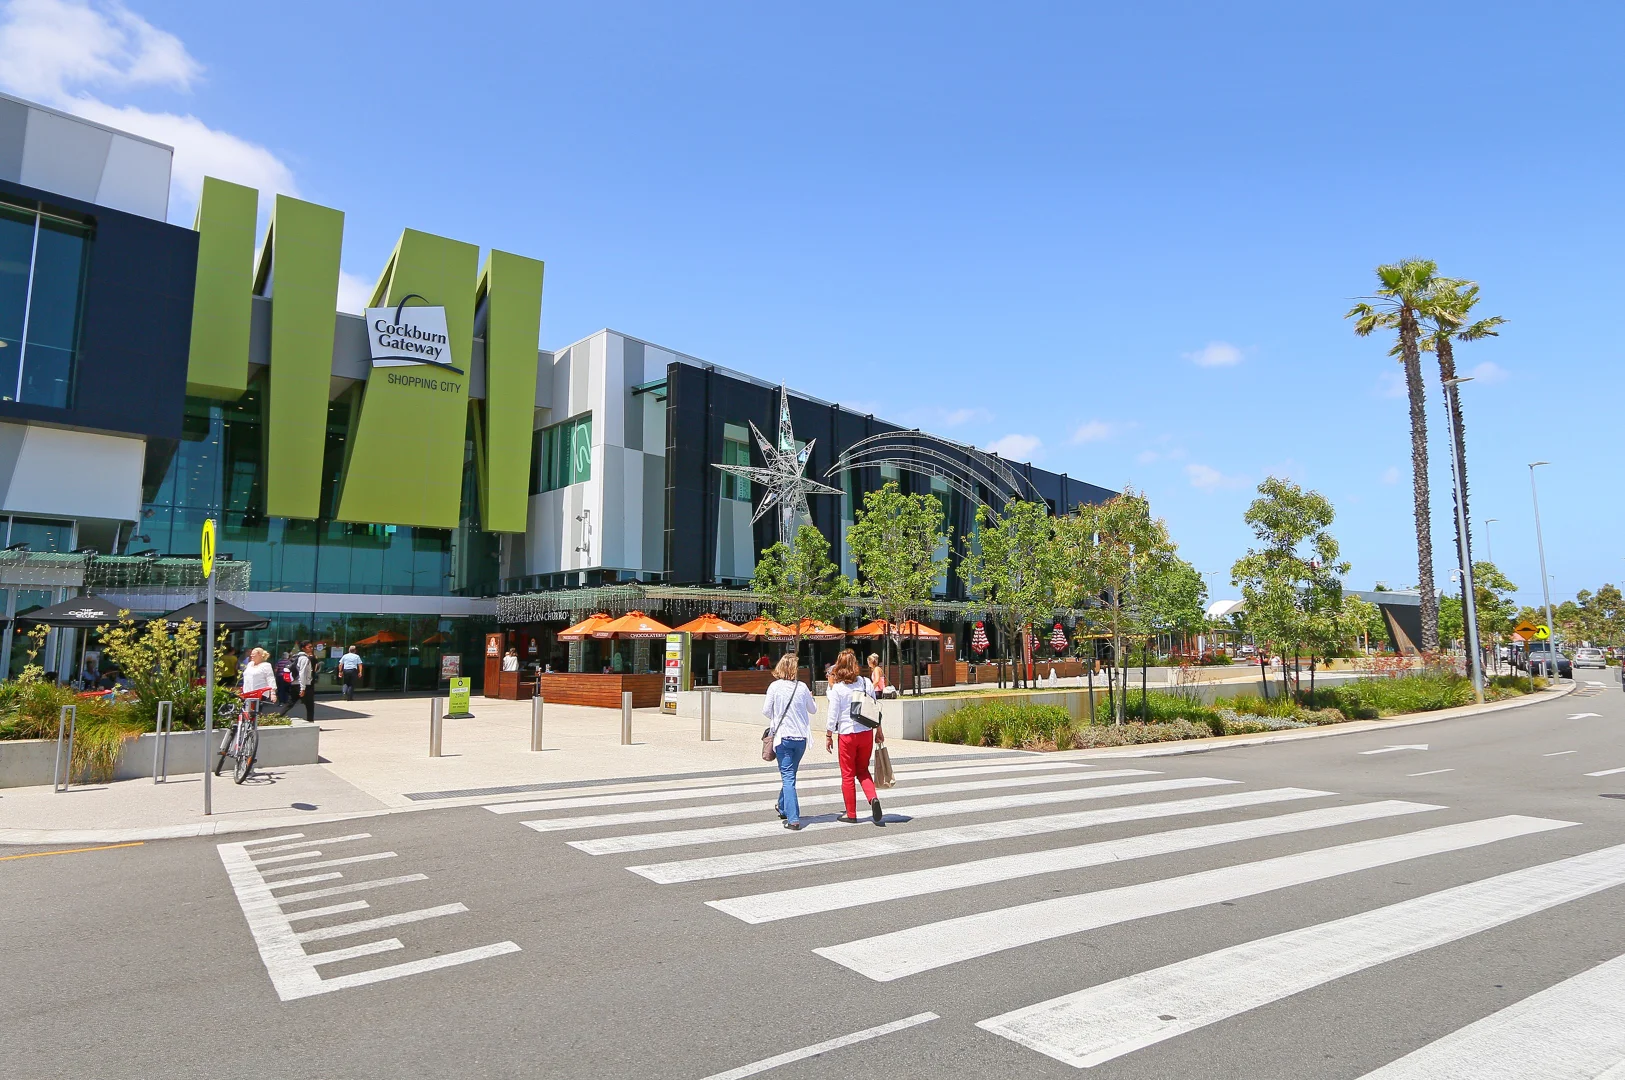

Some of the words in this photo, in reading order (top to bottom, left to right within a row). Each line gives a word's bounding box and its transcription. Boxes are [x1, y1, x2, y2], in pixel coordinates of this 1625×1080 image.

[375, 319, 446, 344] Cockburn
[378, 334, 442, 360] Gateway
[388, 373, 438, 390] SHOPPING
[440, 381, 461, 393] CITY
